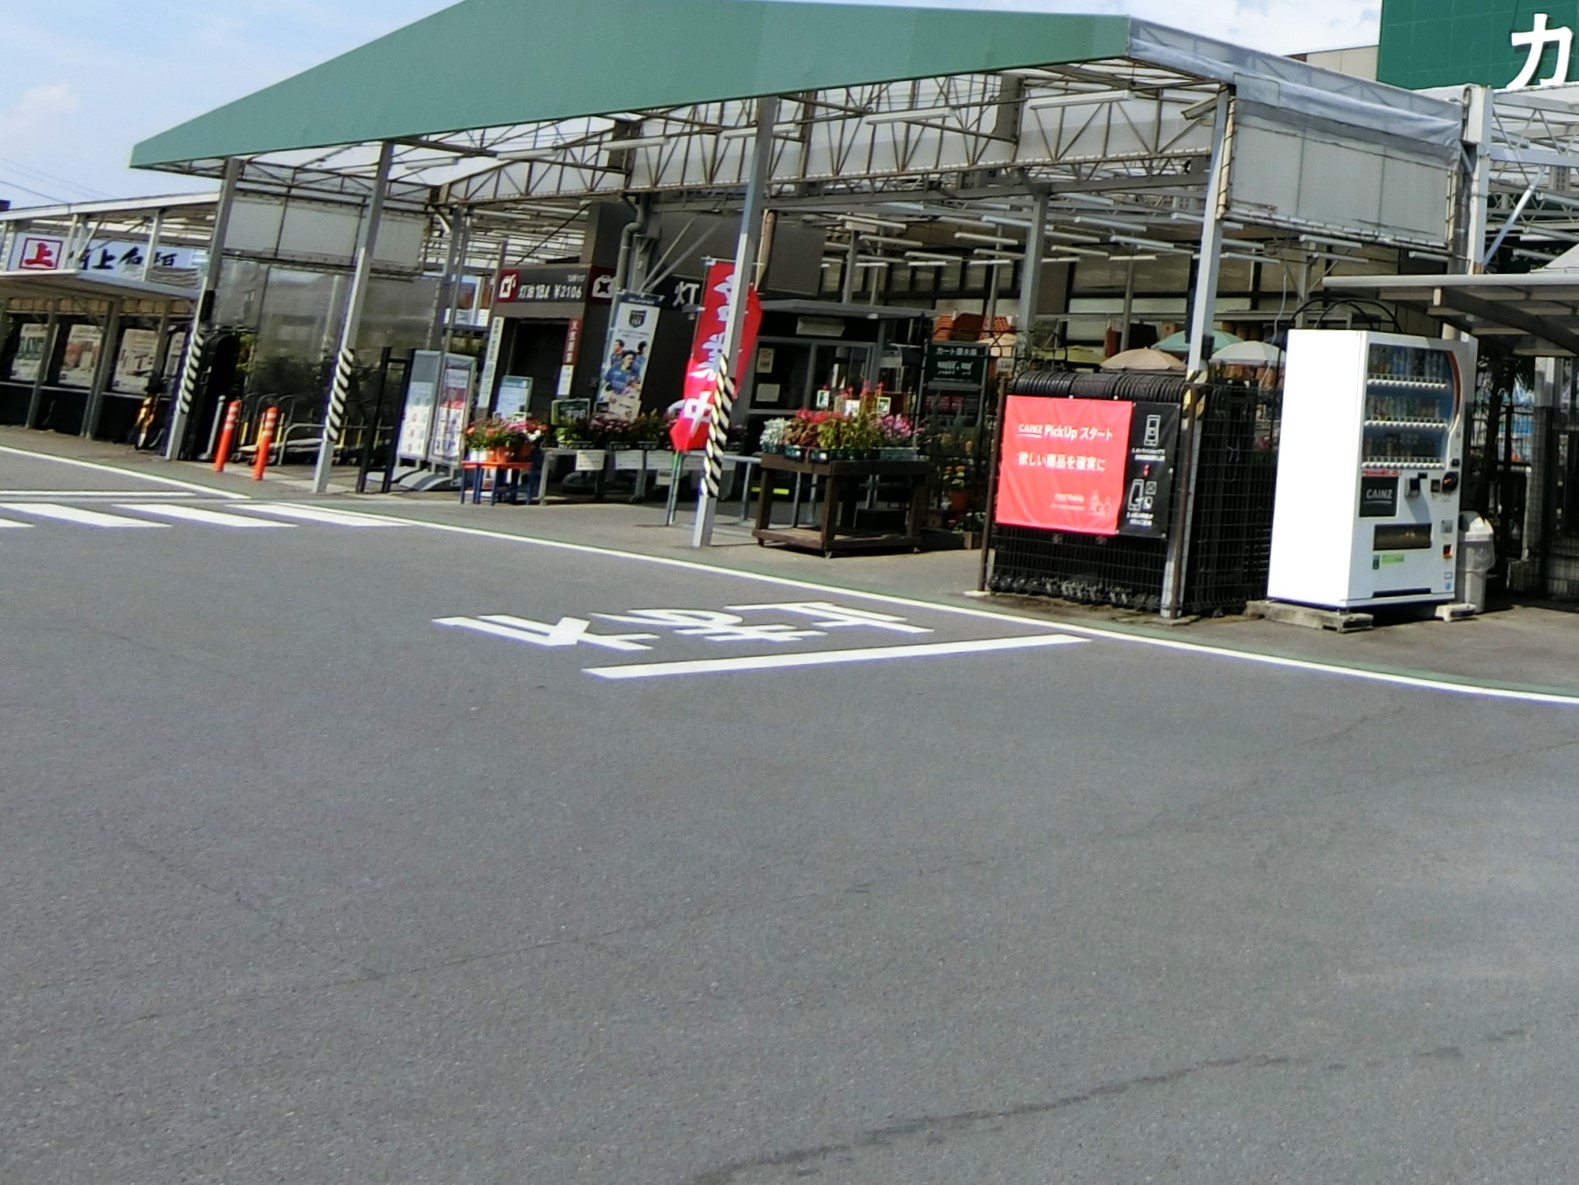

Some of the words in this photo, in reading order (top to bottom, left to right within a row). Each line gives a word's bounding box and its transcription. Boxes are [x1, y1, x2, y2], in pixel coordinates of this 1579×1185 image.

[1044, 424, 1078, 441] PickUp
[1080, 427, 1113, 441] スタート
[1365, 488, 1393, 499] CAINZ
